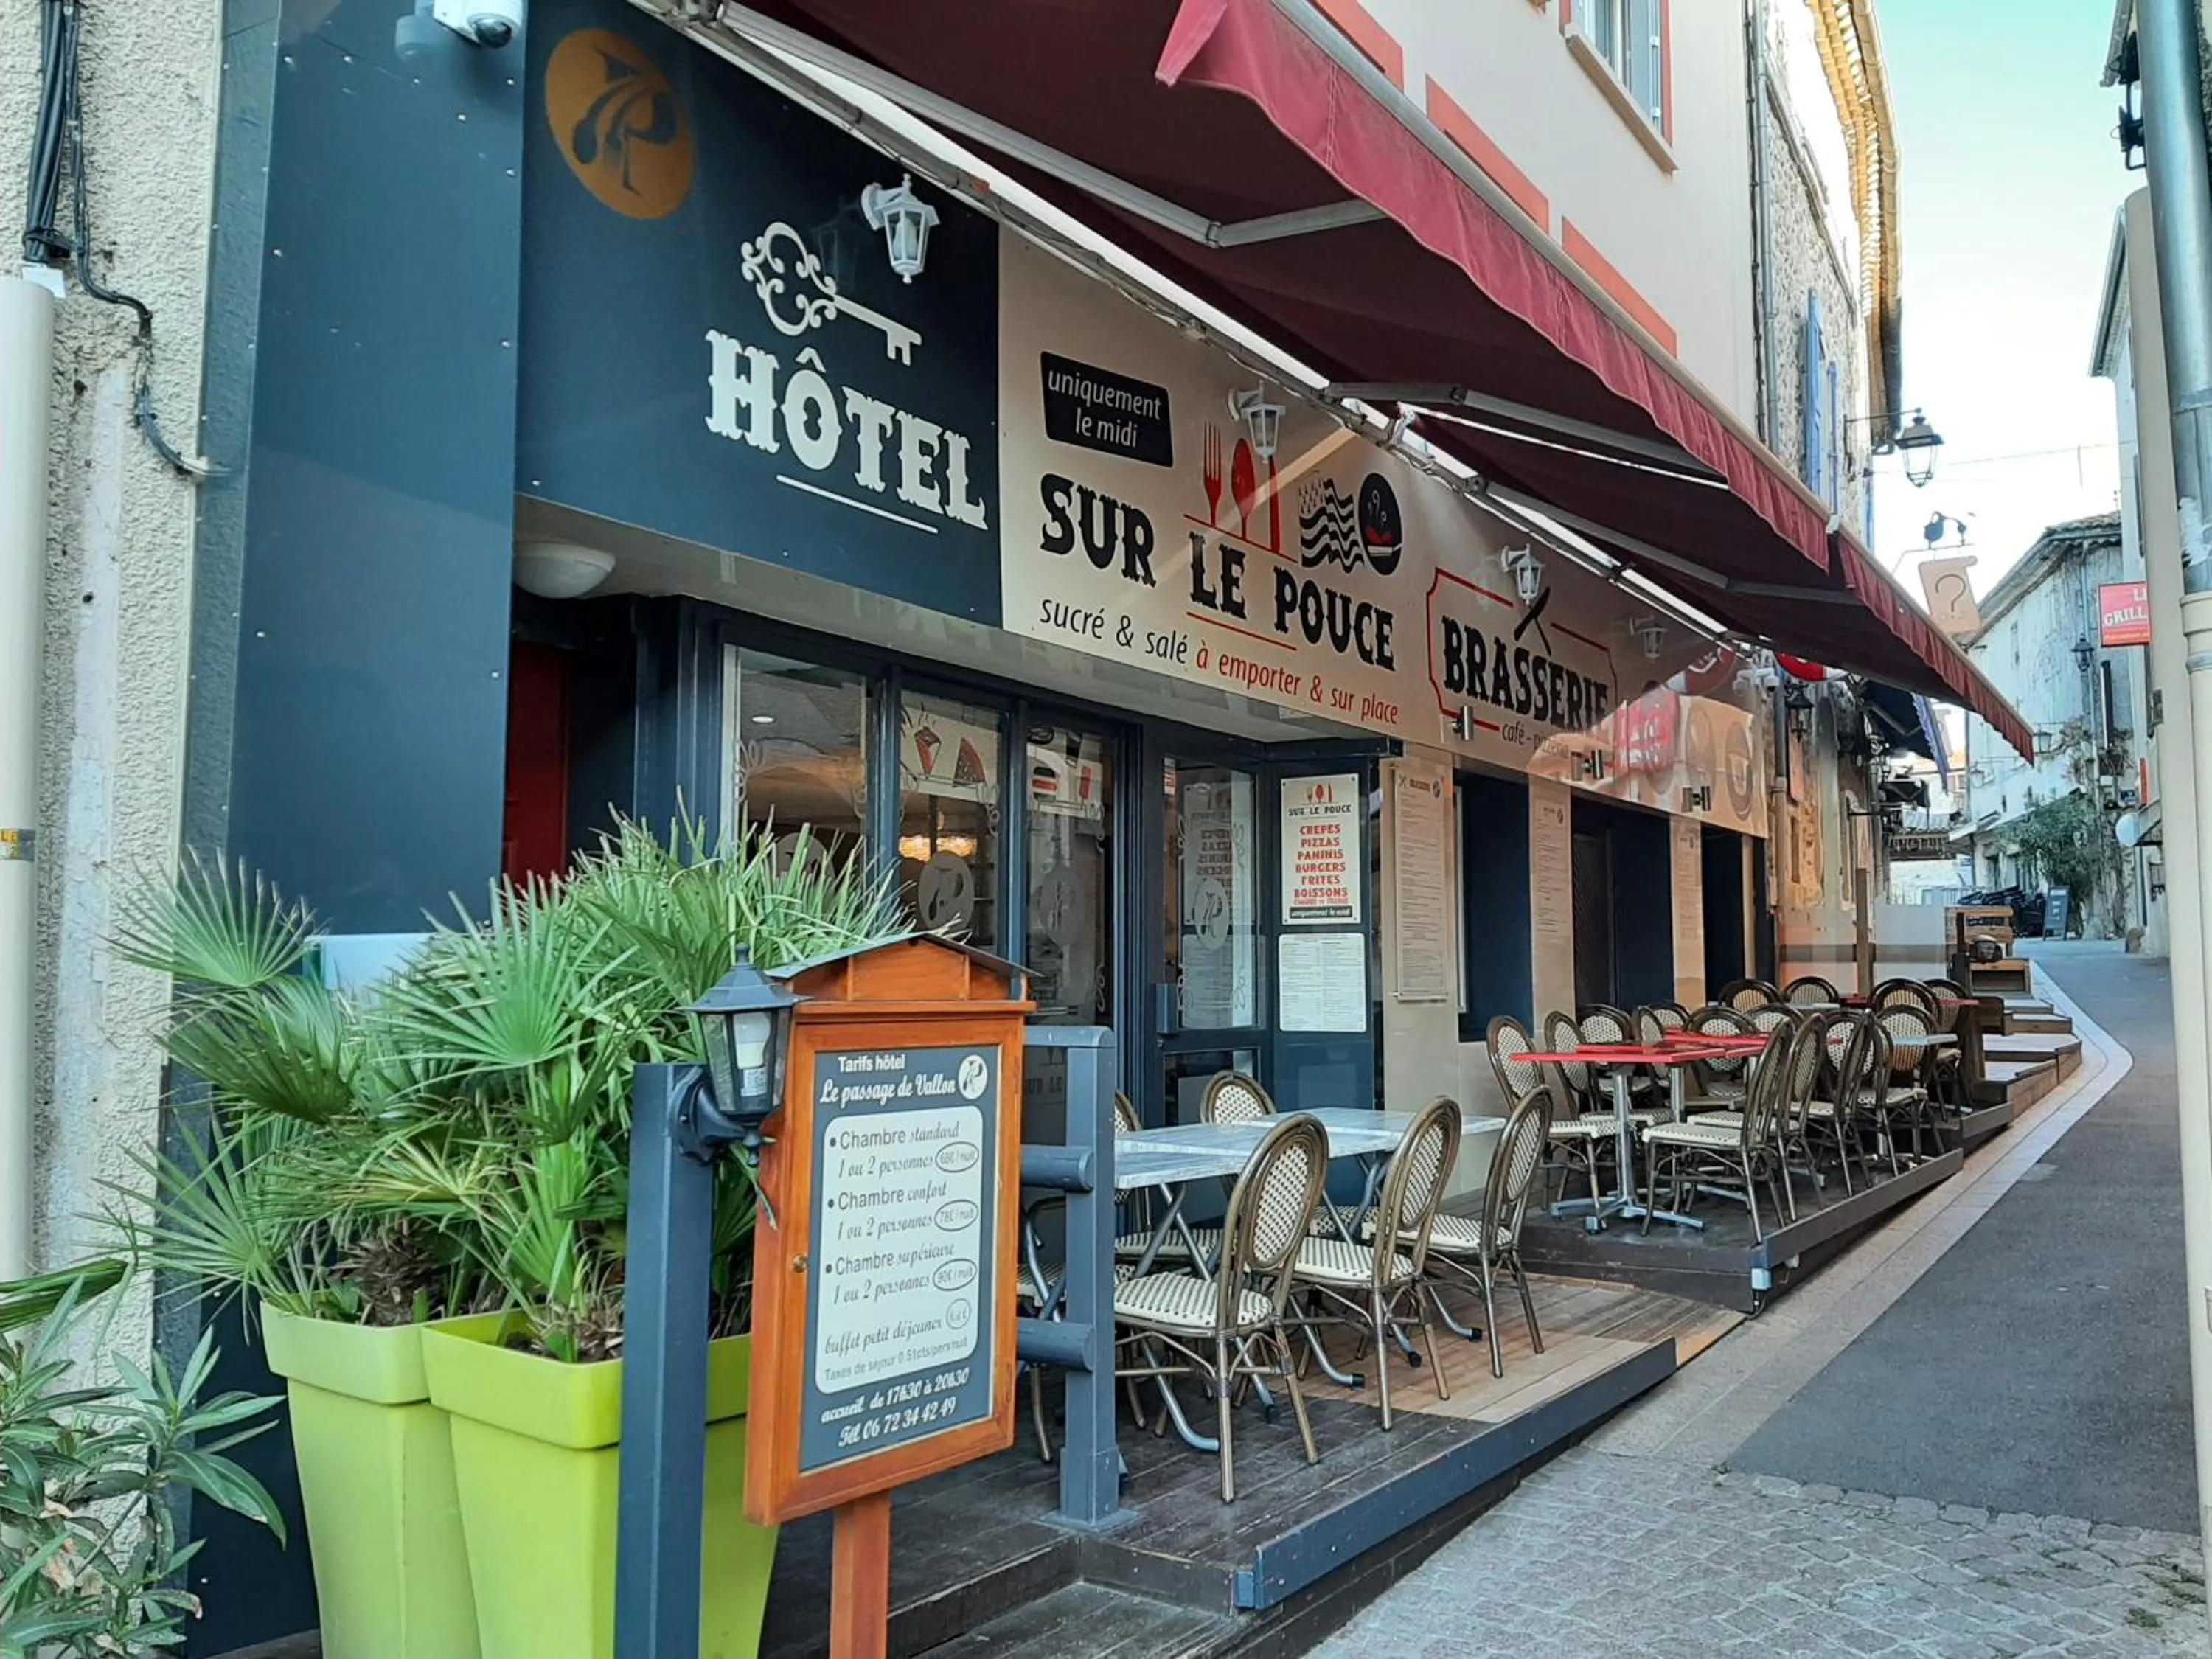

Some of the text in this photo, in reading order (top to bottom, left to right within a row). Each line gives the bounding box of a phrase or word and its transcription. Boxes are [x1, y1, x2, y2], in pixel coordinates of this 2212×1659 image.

[1048, 370, 1162, 420] uniquement
[705, 329, 988, 530] HÔTEL
[1076, 407, 1138, 448] le midi
[1040, 473, 1396, 672] SUR LE POUCE
[1040, 599, 1399, 725] sucré & salé à emporter & sur place
[1441, 615, 1609, 730] BRASSERIE
[1502, 721, 1525, 745] café
[1288, 804, 1351, 816] SUR LE POUCE
[1297, 849, 1344, 860] PANINIS
[1301, 837, 1340, 847] PIZZAS
[1295, 862, 1346, 873] BURGERS
[1301, 874, 1340, 885] FRITES
[1294, 887, 1348, 897] BOISSONS
[838, 1054, 905, 1073] Tarifs hôtel
[819, 1073, 956, 1109] Le passage de Vallon
[840, 1120, 959, 1150] Chambre standard
[849, 1164, 863, 1178] ou
[868, 1155, 876, 1175] 2
[878, 1156, 933, 1180] personnes
[838, 1180, 947, 1210] Chambre confort
[847, 1226, 862, 1239] ou
[866, 1217, 874, 1237] 2
[877, 1215, 932, 1239] personnes
[835, 1252, 894, 1276] Chambre
[843, 1290, 859, 1303] ou
[863, 1279, 872, 1298] 2
[874, 1277, 930, 1303] personnes
[825, 1319, 942, 1357] buffet petit déjeuner
[869, 1391, 885, 1410] de
[886, 1380, 922, 1406] 17h30
[923, 1380, 932, 1396] à
[933, 1367, 970, 1393] 20h30
[862, 1416, 880, 1440] 06
[883, 1411, 901, 1434] 72
[902, 1405, 919, 1428] 34
[922, 1400, 939, 1422] 42
[940, 1396, 956, 1417] 49
